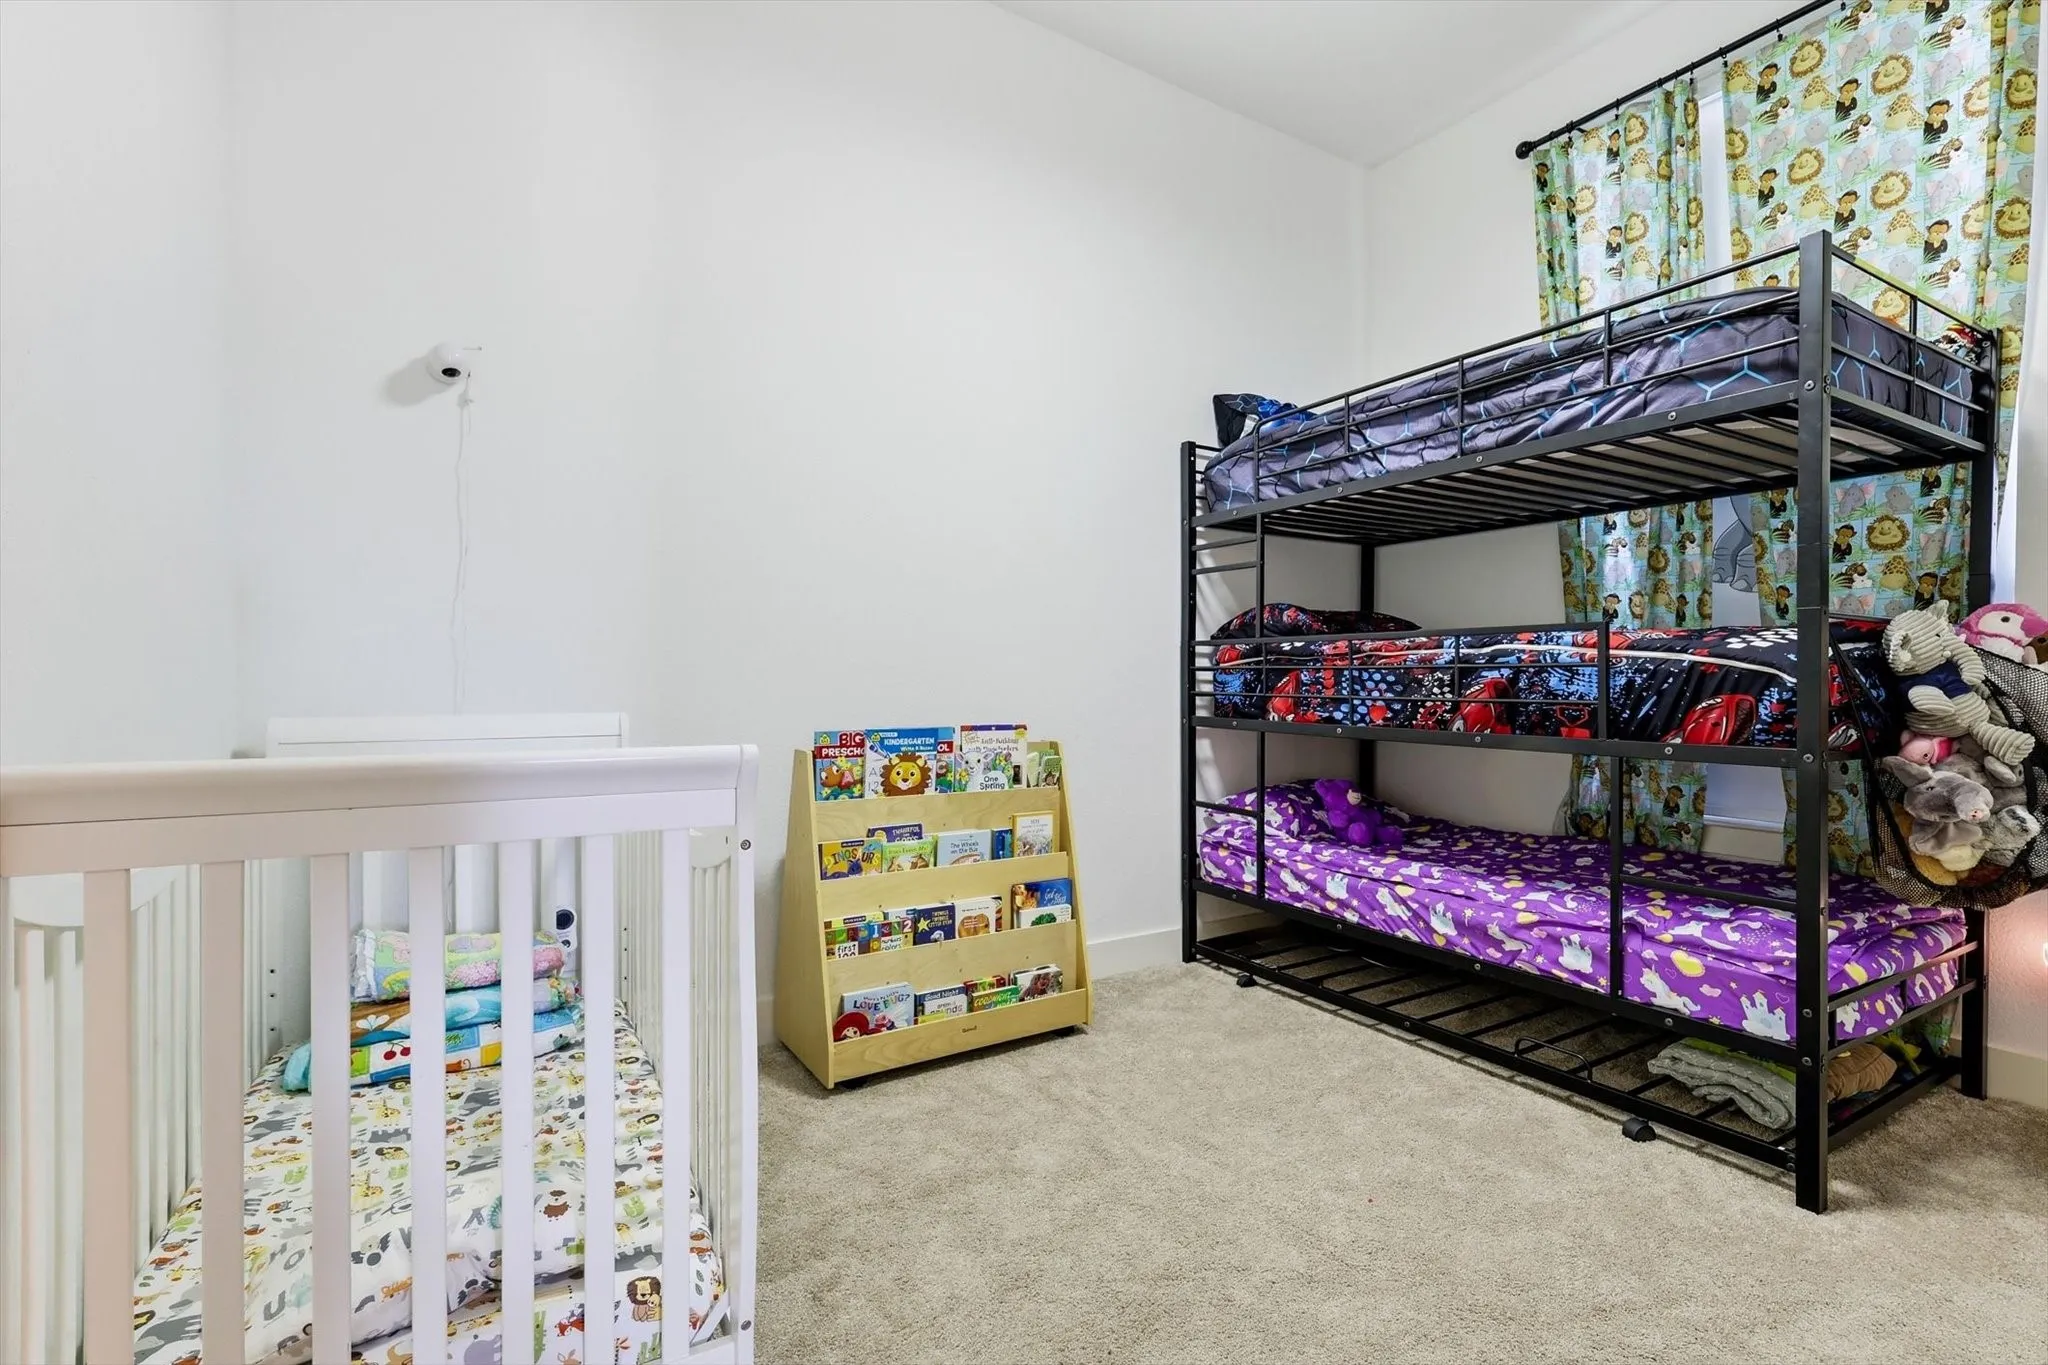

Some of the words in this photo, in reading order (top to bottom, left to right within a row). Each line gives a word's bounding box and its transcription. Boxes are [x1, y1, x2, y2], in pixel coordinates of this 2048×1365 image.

[839, 732, 865, 747] BIG
[884, 737, 935, 746] KINDERGARTEN
[983, 775, 998, 783] One
[980, 782, 1005, 791] Spring
[837, 943, 857, 953] first
[853, 999, 880, 1011] LOVE
[883, 993, 910, 1009] BUG?
